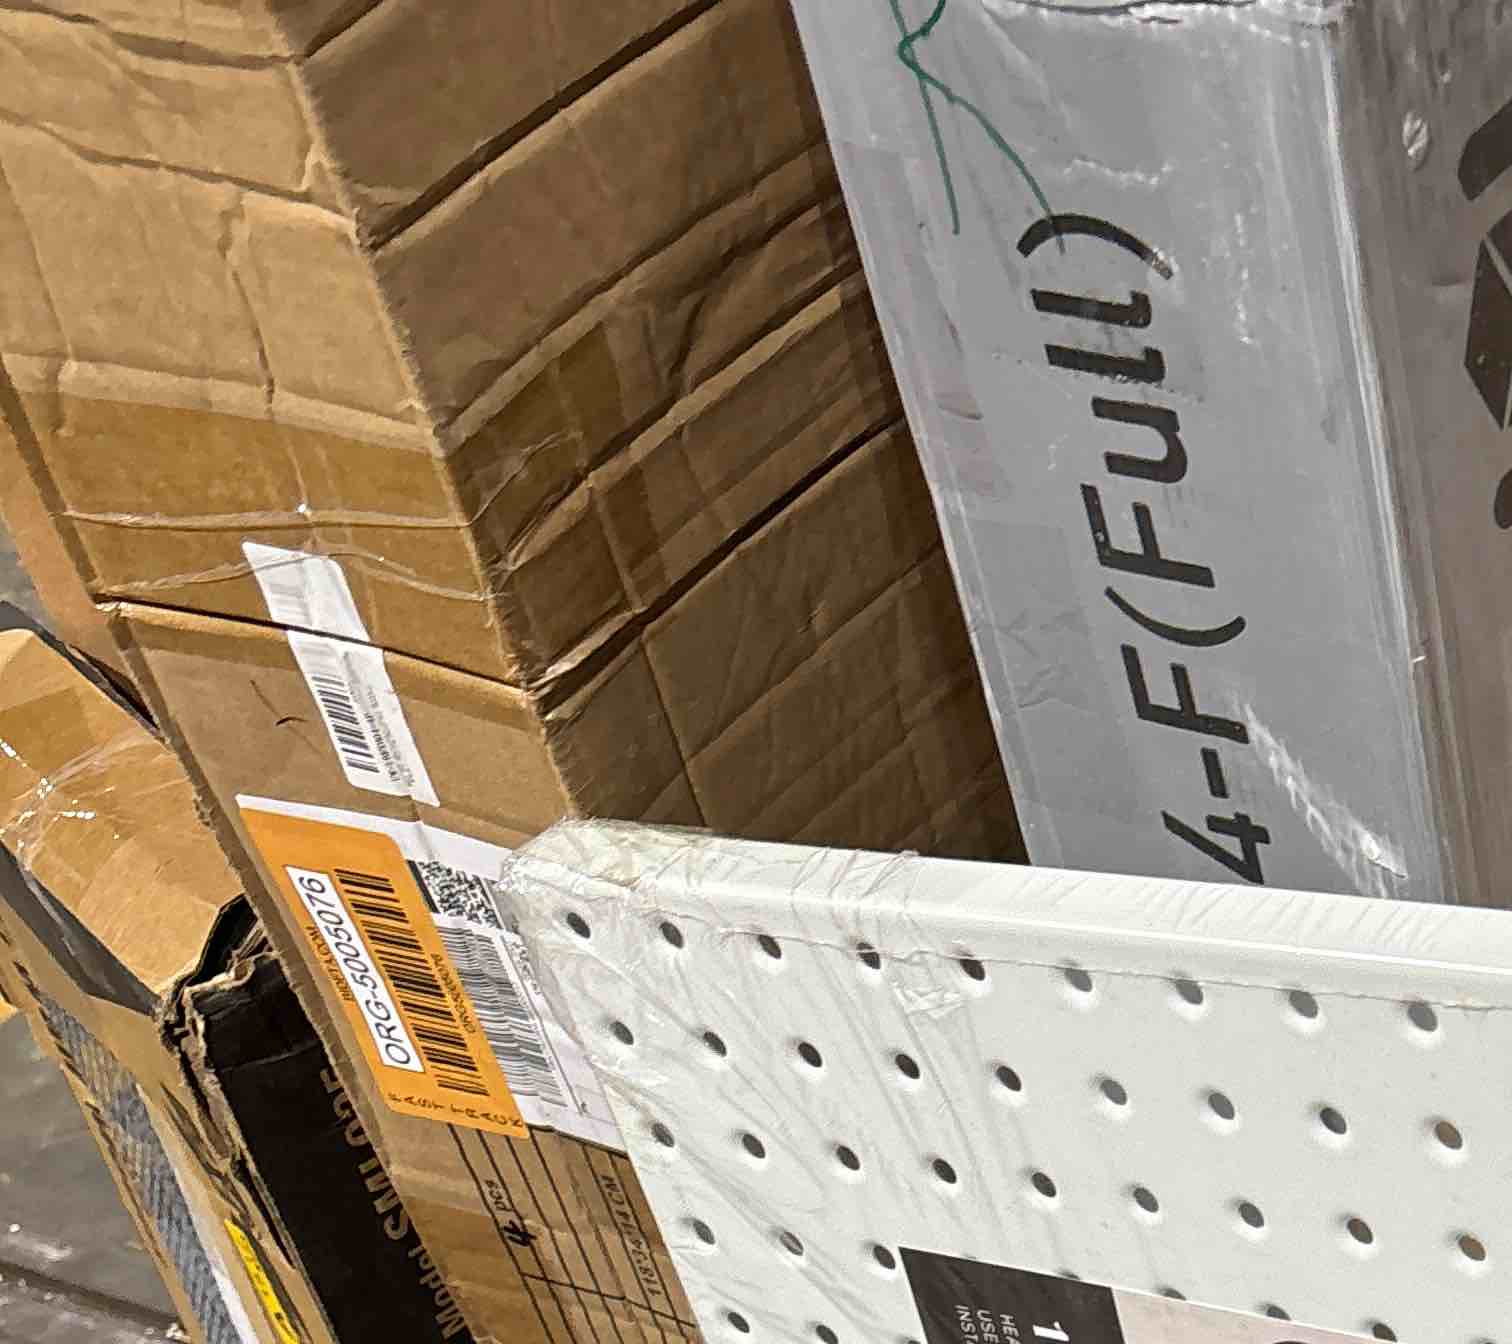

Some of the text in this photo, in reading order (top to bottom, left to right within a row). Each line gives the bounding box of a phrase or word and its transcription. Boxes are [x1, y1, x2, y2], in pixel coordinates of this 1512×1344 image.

[1016, 212, 1271, 886] 4-F(Full)
[299, 875, 411, 1066] ORG-5005076
[976, 1309, 1000, 1344] USE
